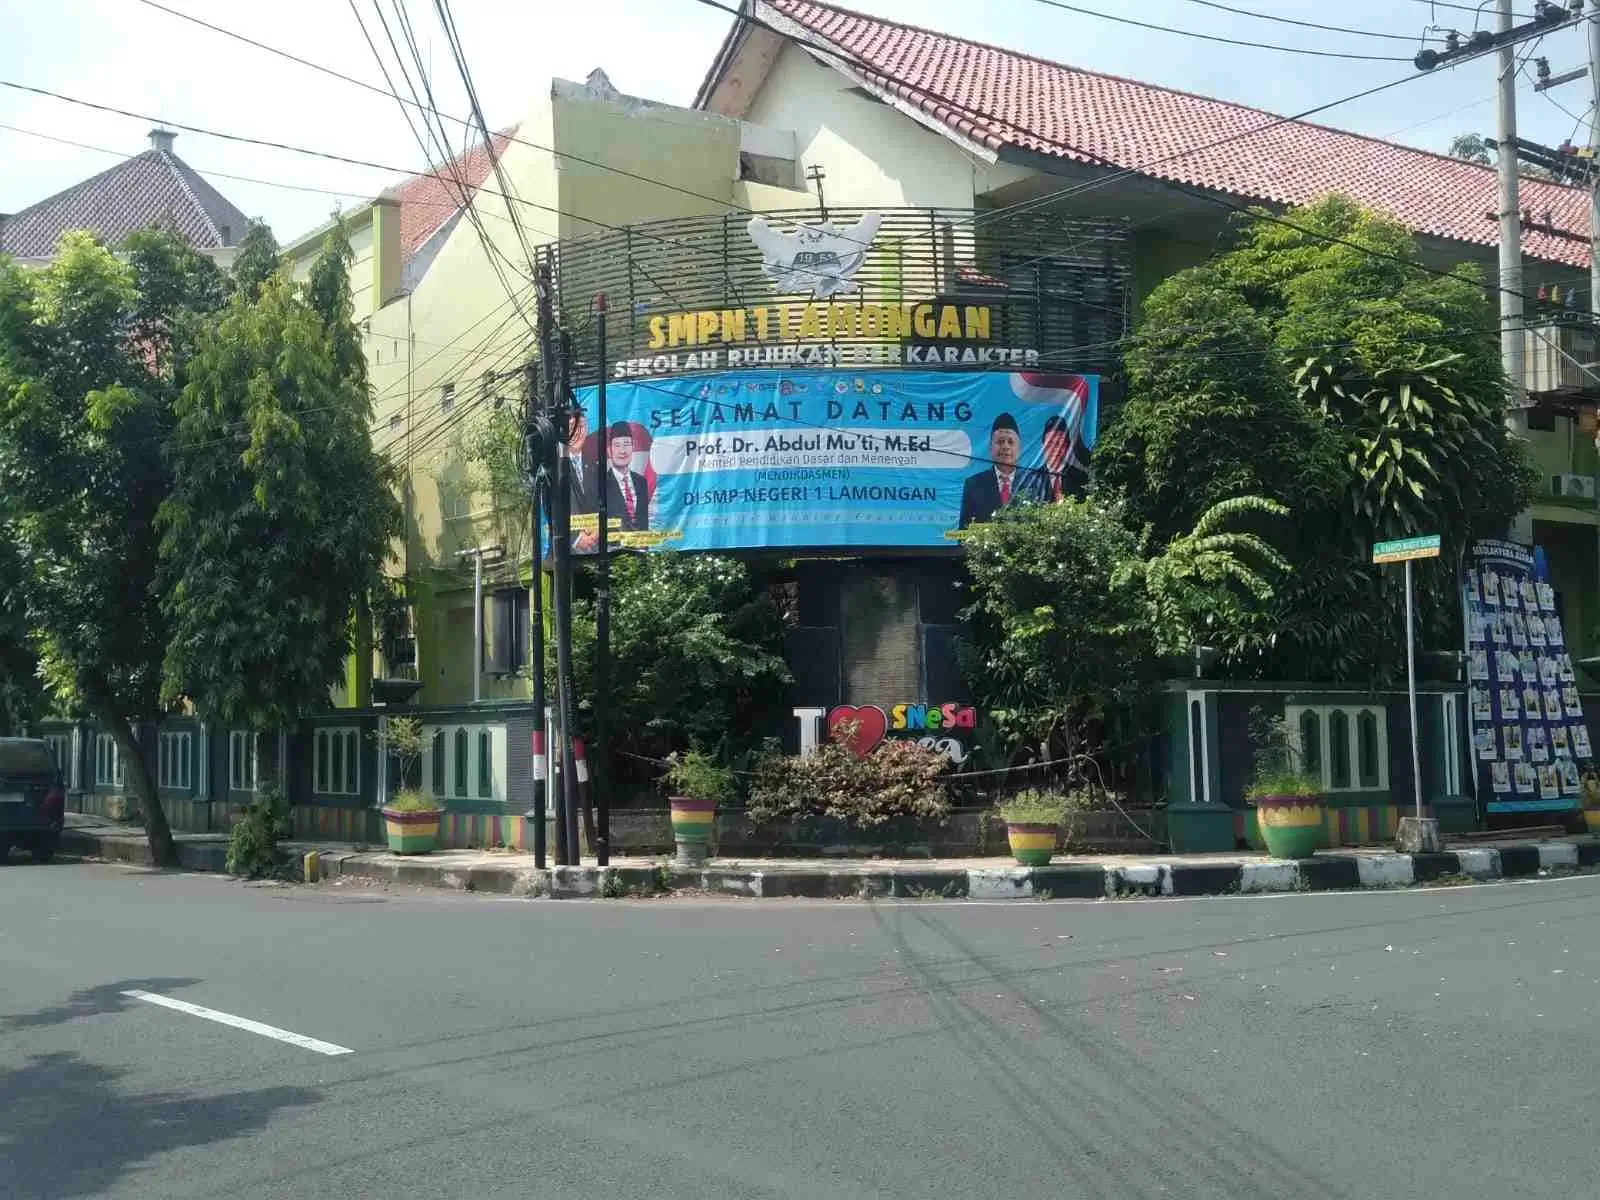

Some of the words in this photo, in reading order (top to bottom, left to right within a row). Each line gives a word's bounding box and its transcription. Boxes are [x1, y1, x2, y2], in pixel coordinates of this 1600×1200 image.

[649, 309, 745, 349] SMPN
[754, 307, 768, 340] 1
[779, 303, 990, 341] LAMONGAN
[614, 350, 717, 378] SEKOLAH
[728, 345, 842, 368] RUJUKAN
[650, 401, 802, 428] SELAMAT
[827, 401, 973, 422] DATANG
[686, 437, 726, 456] Prof.
[732, 437, 759, 453] Dr.
[765, 434, 820, 452] Abdul
[827, 434, 879, 452] Mu'ti,
[886, 436, 930, 451] M.Ed
[740, 454, 799, 466] Pendidikan
[803, 454, 835, 464] Dasar
[838, 453, 858, 464] dan
[861, 453, 918, 466] Menengah
[684, 491, 699, 505] DI
[703, 489, 738, 504] SMP
[744, 486, 808, 502] NEGERI
[814, 486, 821, 499] 1
[829, 486, 936, 500] LAMONGAN
